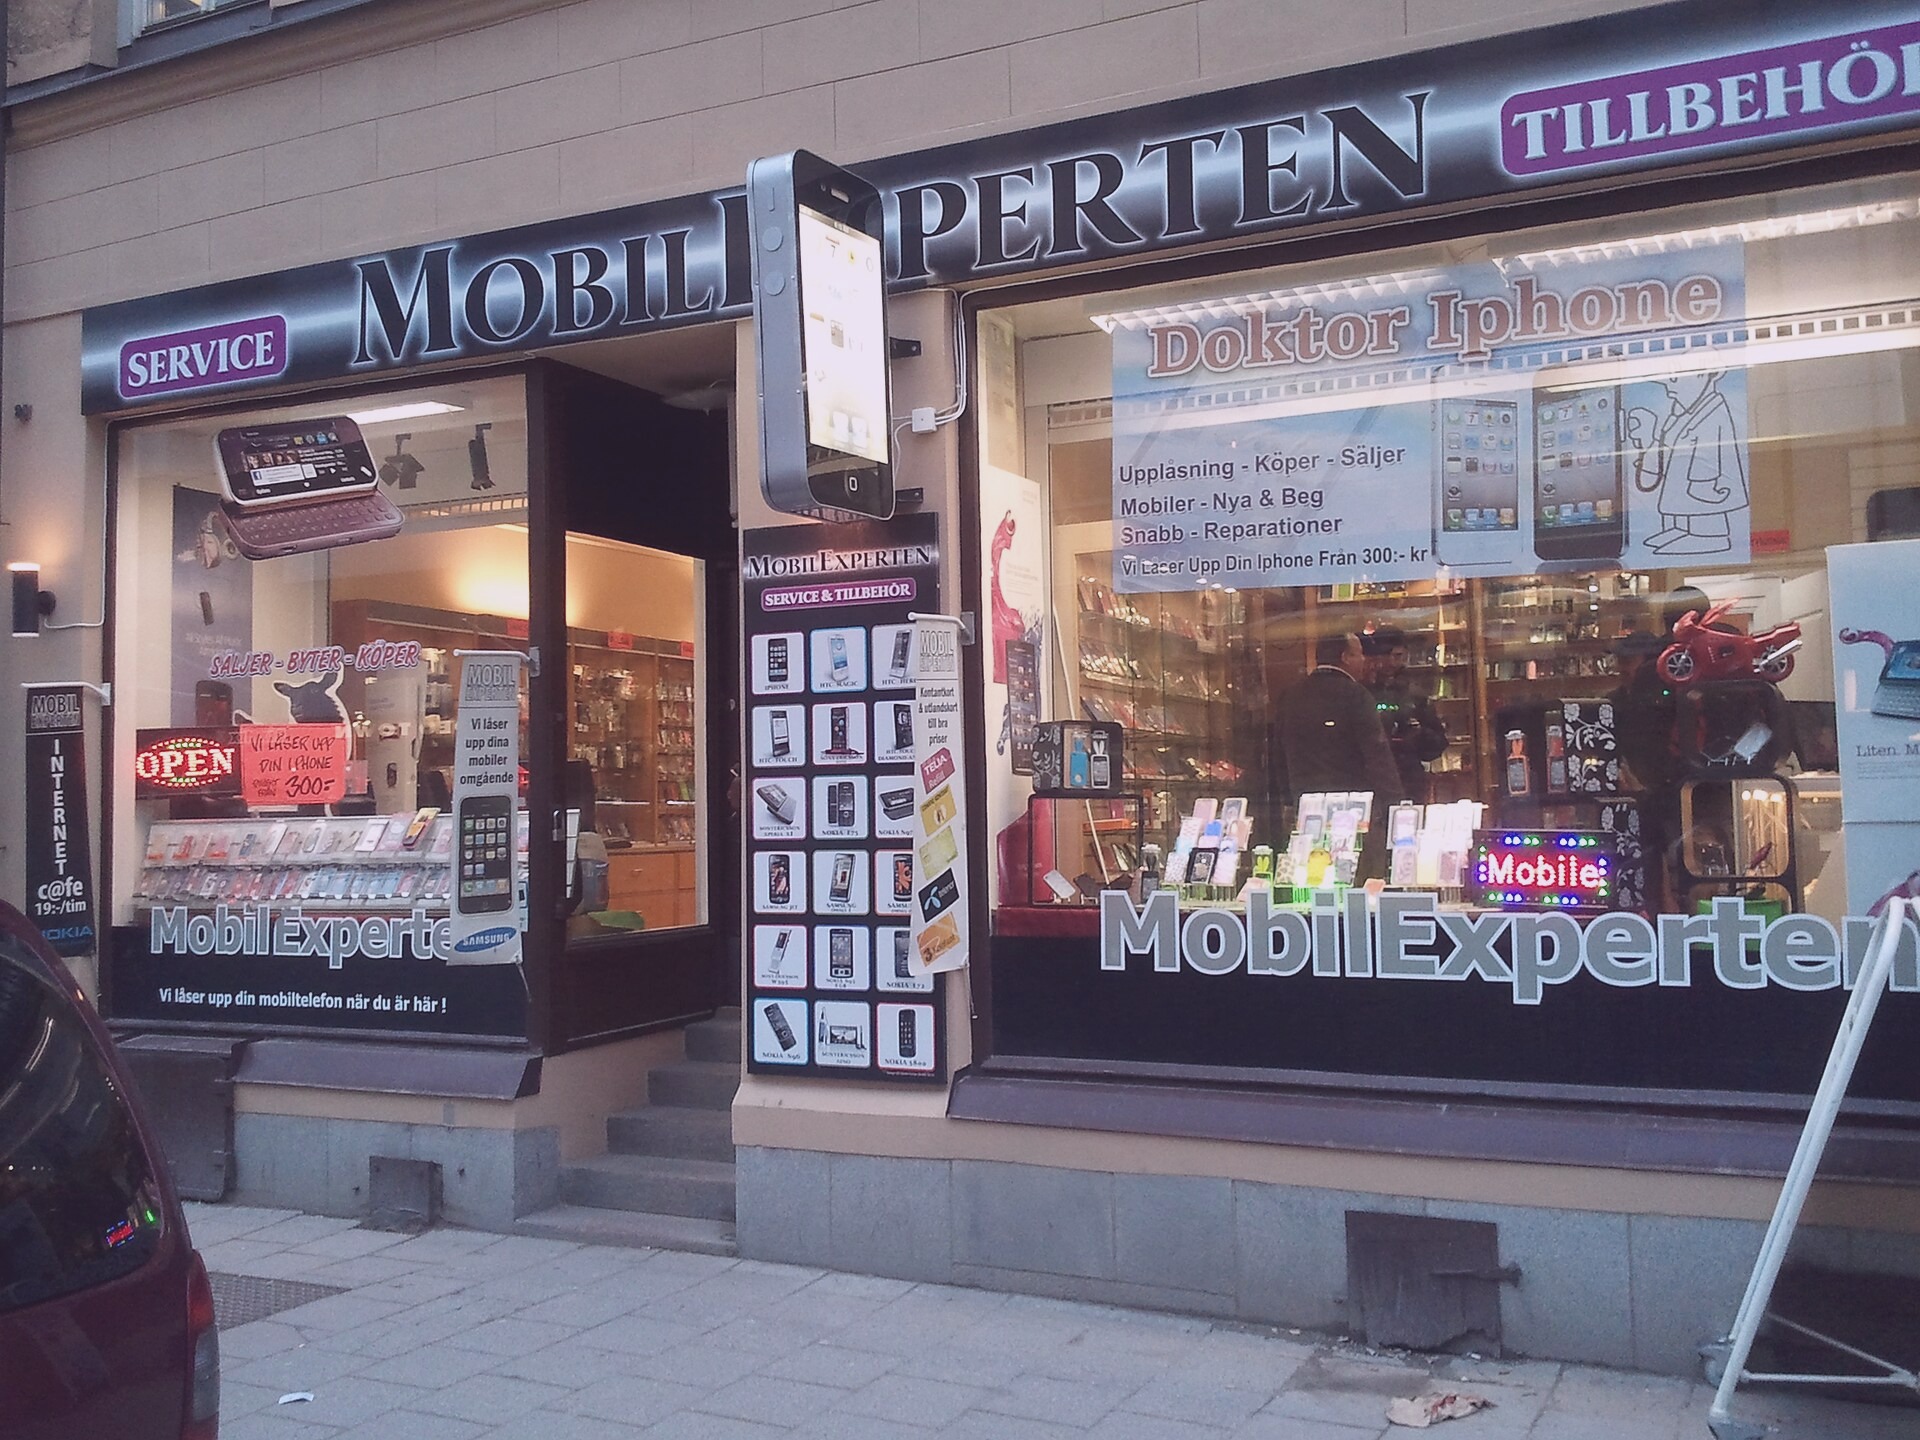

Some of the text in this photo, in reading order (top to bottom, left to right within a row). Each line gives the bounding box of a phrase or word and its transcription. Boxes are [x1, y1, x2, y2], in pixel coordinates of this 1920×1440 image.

[351, 89, 1433, 367] MOBILPERTEN
[1147, 274, 1722, 379] Doktor Iphone
[127, 331, 275, 388] SERVICE
[1119, 458, 1235, 487] Upplåsning
[1255, 451, 1320, 475] Köper
[1340, 444, 1406, 470] Säljer
[1120, 494, 1196, 517] Mobiler
[1213, 492, 1252, 514] Nya
[1259, 488, 1274, 507] &
[1281, 487, 1325, 509] Beg
[1120, 523, 1185, 545] Snabb
[1204, 516, 1343, 542] Reparationer
[1121, 559, 1137, 576] Vi
[1189, 556, 1221, 576] Upp
[1225, 554, 1252, 572] Din
[1257, 551, 1315, 572] Iphone
[1318, 547, 1358, 567] Från
[1410, 545, 1428, 562] kr
[764, 582, 912, 607] SERVICE & TILLBEHÖR
[287, 645, 345, 673] BYTER
[355, 639, 422, 672] KÖPER
[466, 664, 516, 687] MOBIL
[32, 693, 80, 716] MOBIL
[471, 716, 509, 730] Vi låser
[938, 718, 949, 729] bra
[251, 734, 262, 752] VI
[312, 736, 336, 751] UPP
[465, 736, 509, 751] upp dina
[136, 746, 235, 781] OPEN
[259, 757, 282, 773] DIN
[468, 754, 508, 767] mobiler
[923, 754, 948, 776] TELIA
[460, 769, 514, 787] omgående
[1487, 853, 1600, 890] Mobile
[37, 876, 84, 902] c@fe
[150, 905, 452, 970] MobilExperte
[462, 931, 513, 946] SAMSUNG
[159, 988, 173, 1003] Vi
[174, 988, 206, 1004] låser
[208, 992, 232, 1009] upp
[235, 990, 256, 1006] din
[259, 991, 343, 1009] mobiltelefon
[346, 993, 370, 1010] när
[373, 993, 391, 1011] du
[394, 994, 410, 1011] är
[413, 996, 438, 1013] här
